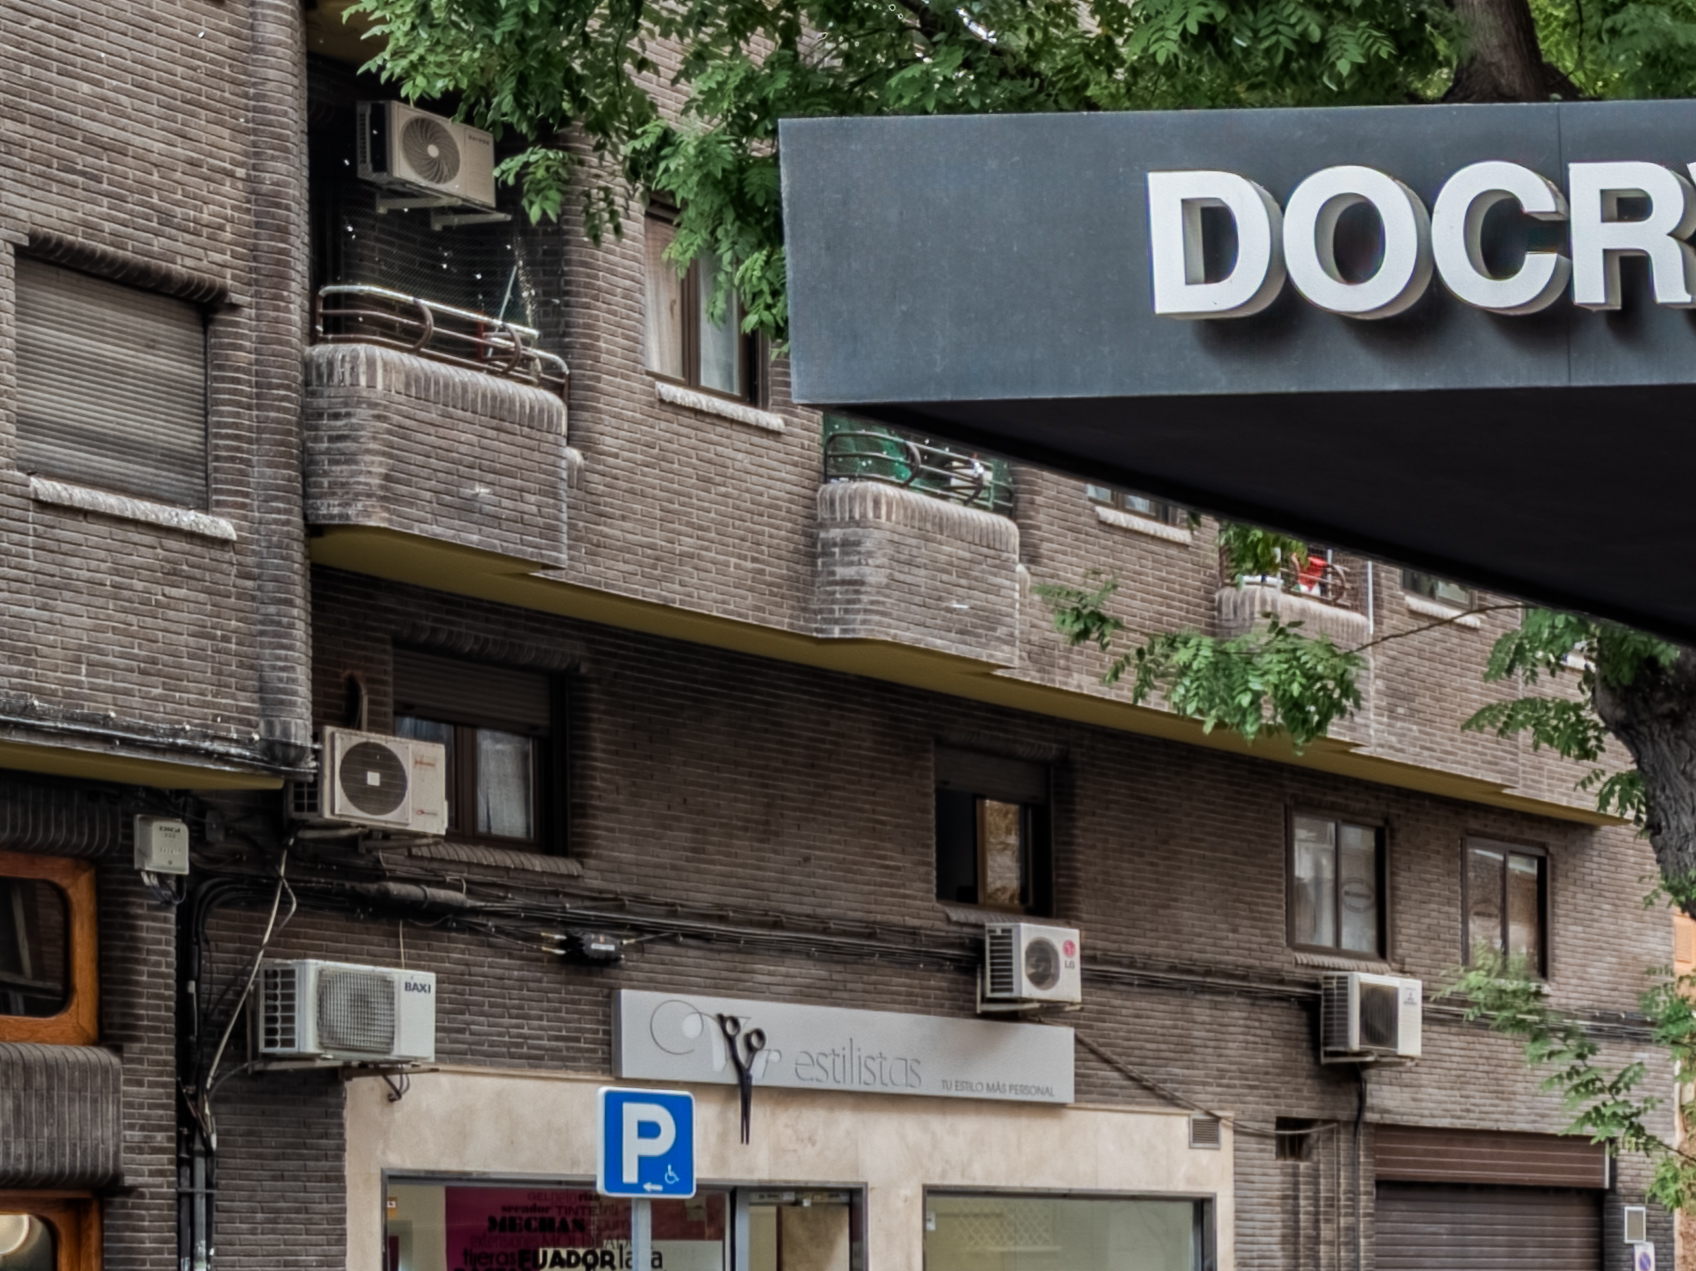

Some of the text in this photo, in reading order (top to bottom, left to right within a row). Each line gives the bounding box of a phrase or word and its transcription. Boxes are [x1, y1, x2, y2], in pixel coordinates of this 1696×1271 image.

[404, 980, 431, 995] BAXI
[794, 1037, 922, 1089] estilistas
[941, 1079, 953, 1090] TU
[954, 1080, 985, 1093] ESTILO
[1008, 1082, 1055, 1097] PERSONAL
[621, 1101, 677, 1184] P
[501, 1203, 551, 1214] secador
[487, 1216, 586, 1233] MECHAS
[462, 1243, 663, 1270] tijeras FIJADOR laa
